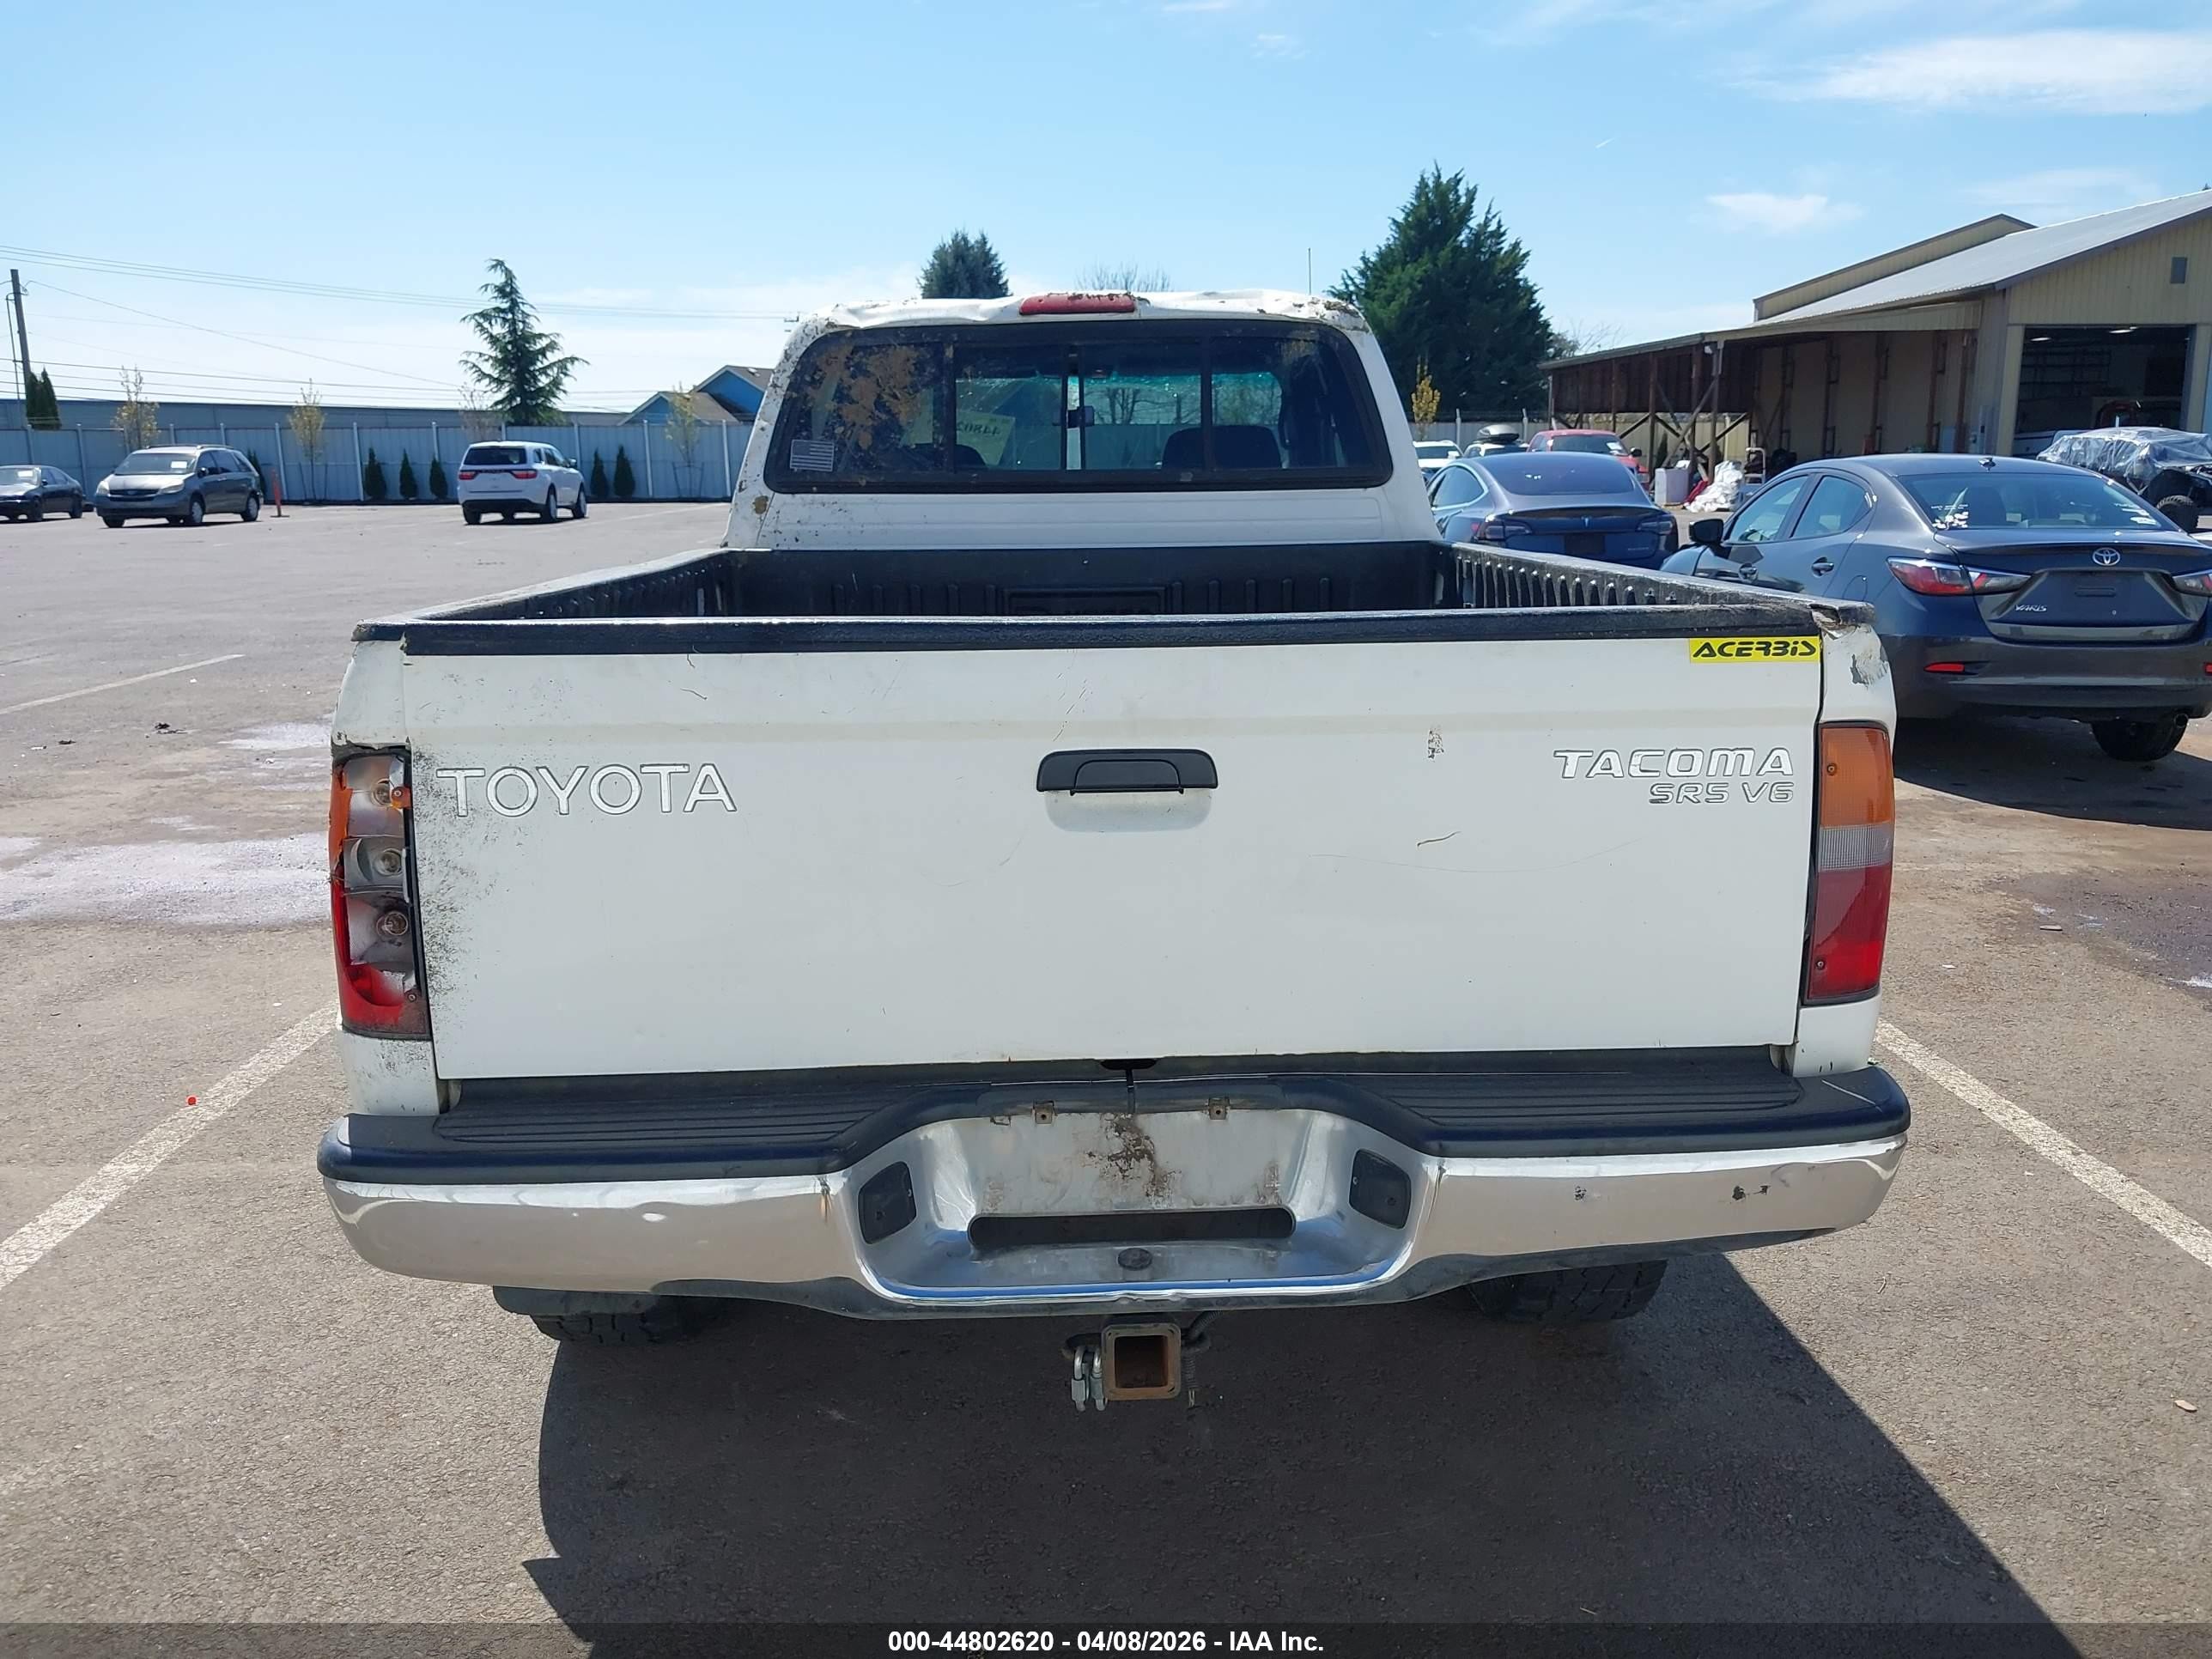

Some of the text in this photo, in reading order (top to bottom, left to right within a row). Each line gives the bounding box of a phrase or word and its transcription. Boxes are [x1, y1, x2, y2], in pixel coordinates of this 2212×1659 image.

[1553, 746, 1795, 779] TACOMA
[436, 763, 737, 817] TOYOTA
[1741, 781, 1795, 804] V6
